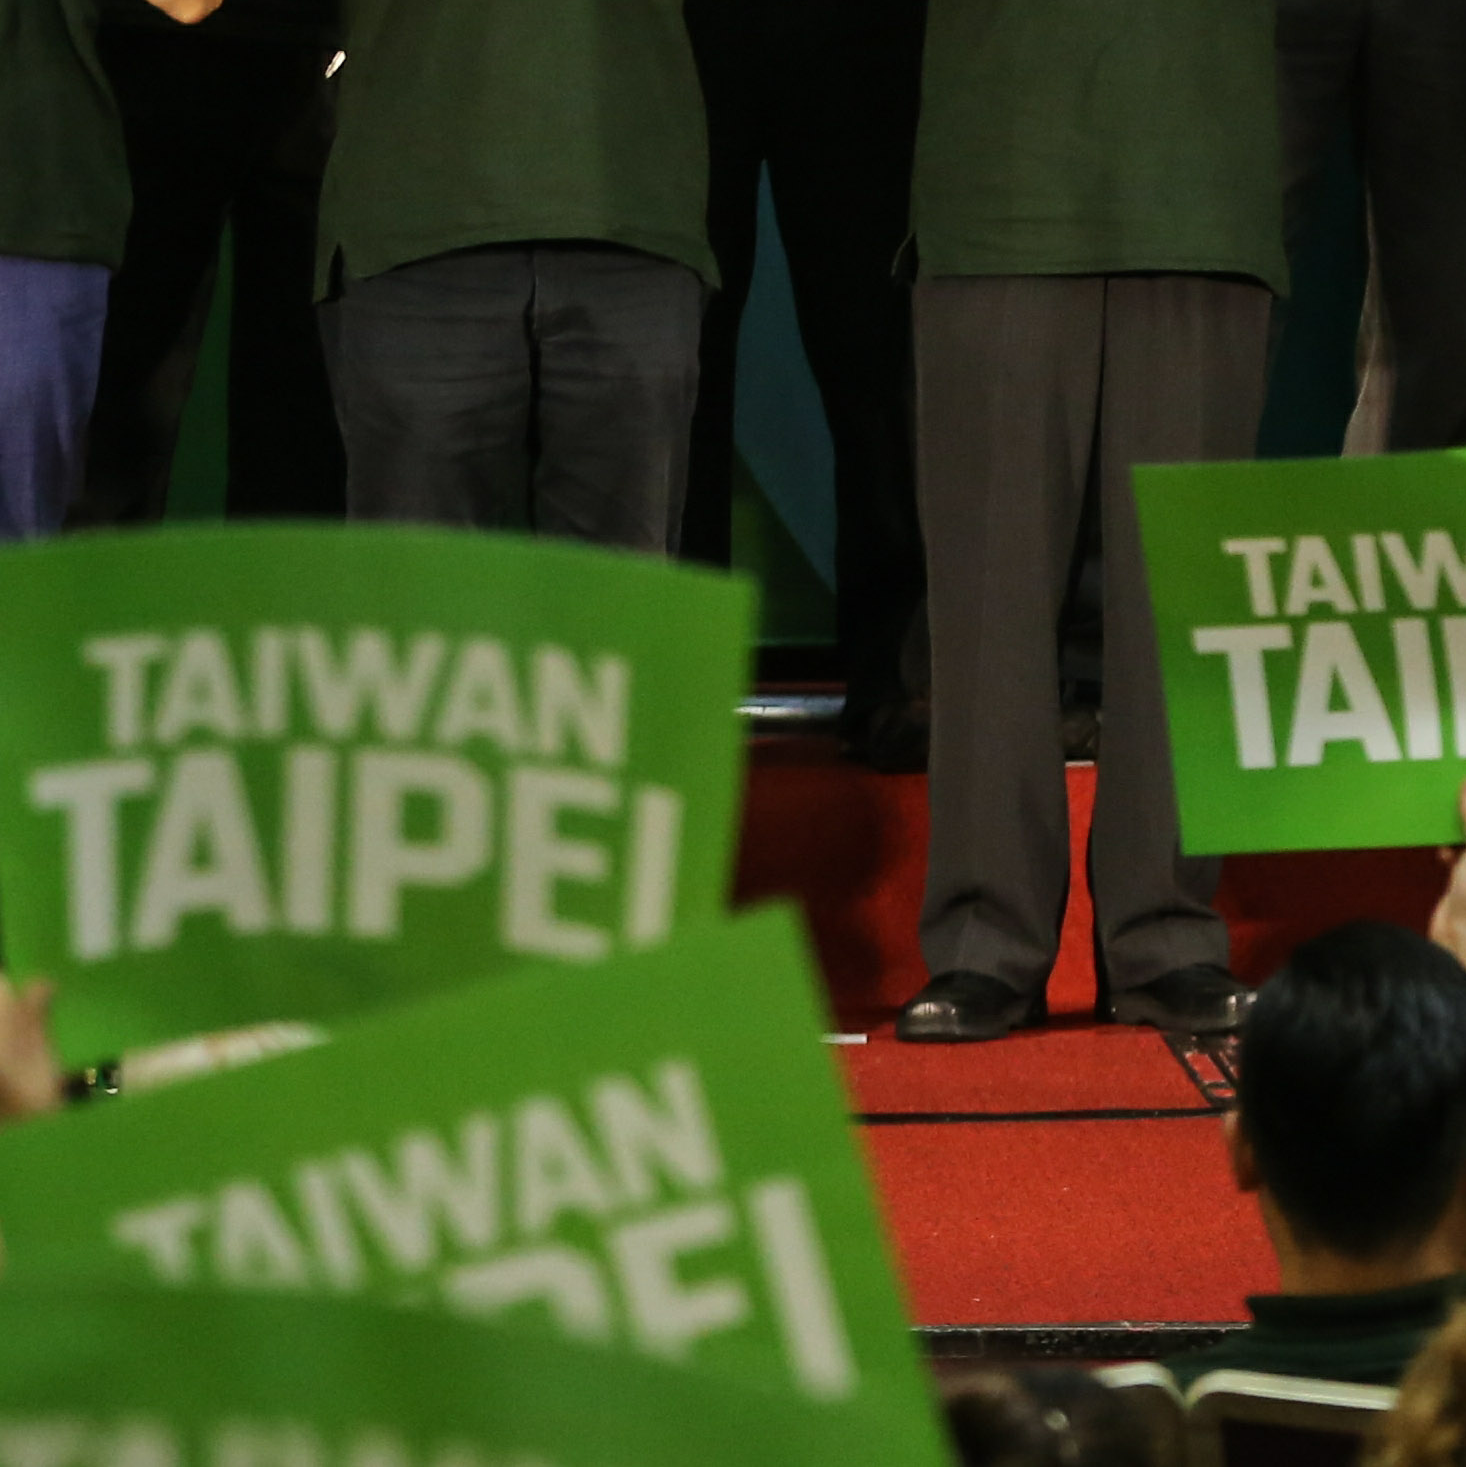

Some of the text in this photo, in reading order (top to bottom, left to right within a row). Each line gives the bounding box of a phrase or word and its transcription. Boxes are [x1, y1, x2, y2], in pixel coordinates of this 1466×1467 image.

[81, 624, 632, 766] TAIWAN
[29, 743, 683, 962] TAIPEI
[111, 1060, 726, 1296] TAIWAN
